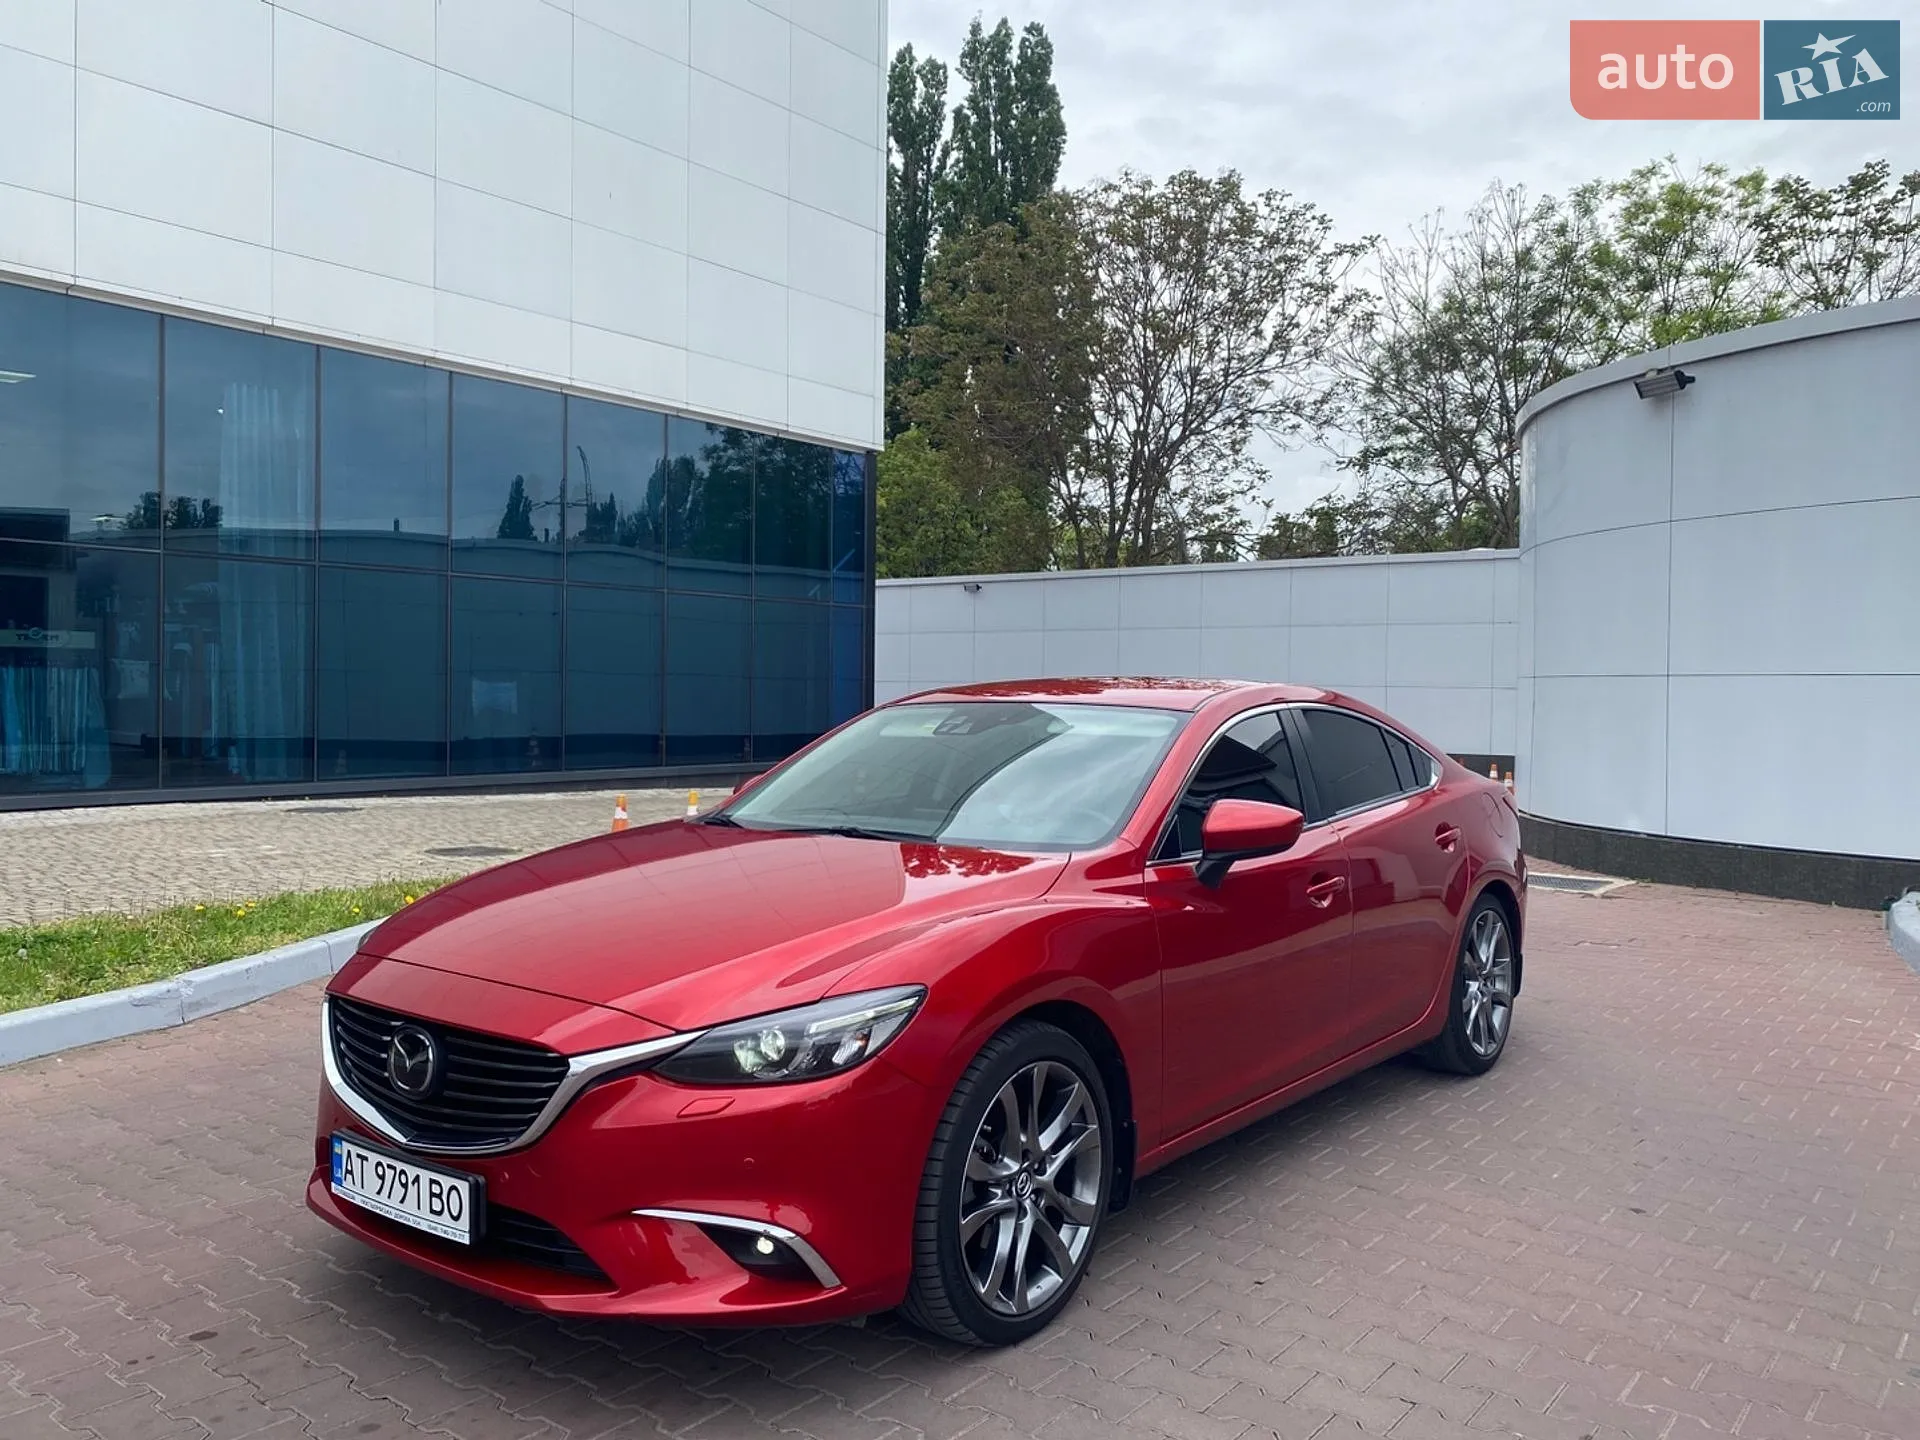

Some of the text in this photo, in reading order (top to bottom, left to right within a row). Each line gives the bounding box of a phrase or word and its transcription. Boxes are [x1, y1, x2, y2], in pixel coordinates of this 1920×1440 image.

[344, 1149, 463, 1222] AT 9791 BO
